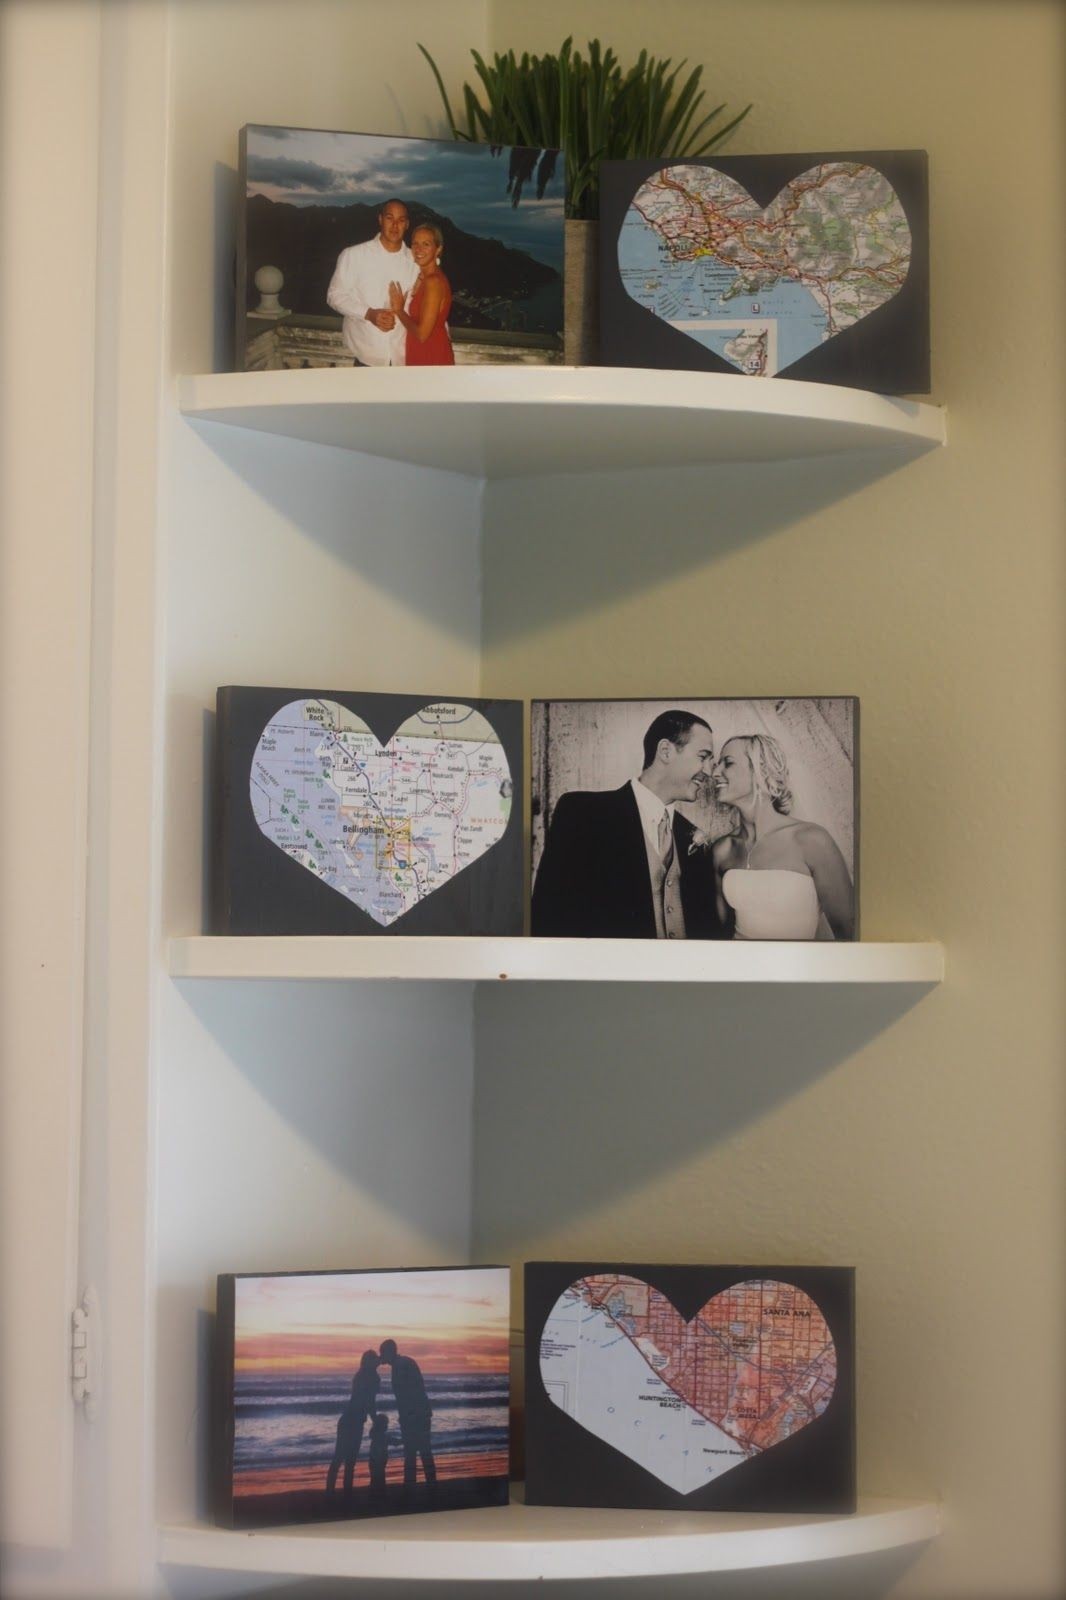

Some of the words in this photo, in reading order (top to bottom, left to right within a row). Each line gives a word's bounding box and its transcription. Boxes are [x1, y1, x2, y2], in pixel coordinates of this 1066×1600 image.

[305, 706, 325, 714] White
[422, 706, 456, 715] Abbotsford
[375, 749, 398, 757] Lynden
[342, 825, 385, 835] Bellingham
[763, 1308, 790, 1317] SANTA
[793, 1310, 811, 1318] ANA
[639, 1394, 682, 1403] HUNTINGTON
[702, 1448, 728, 1456] Newport
